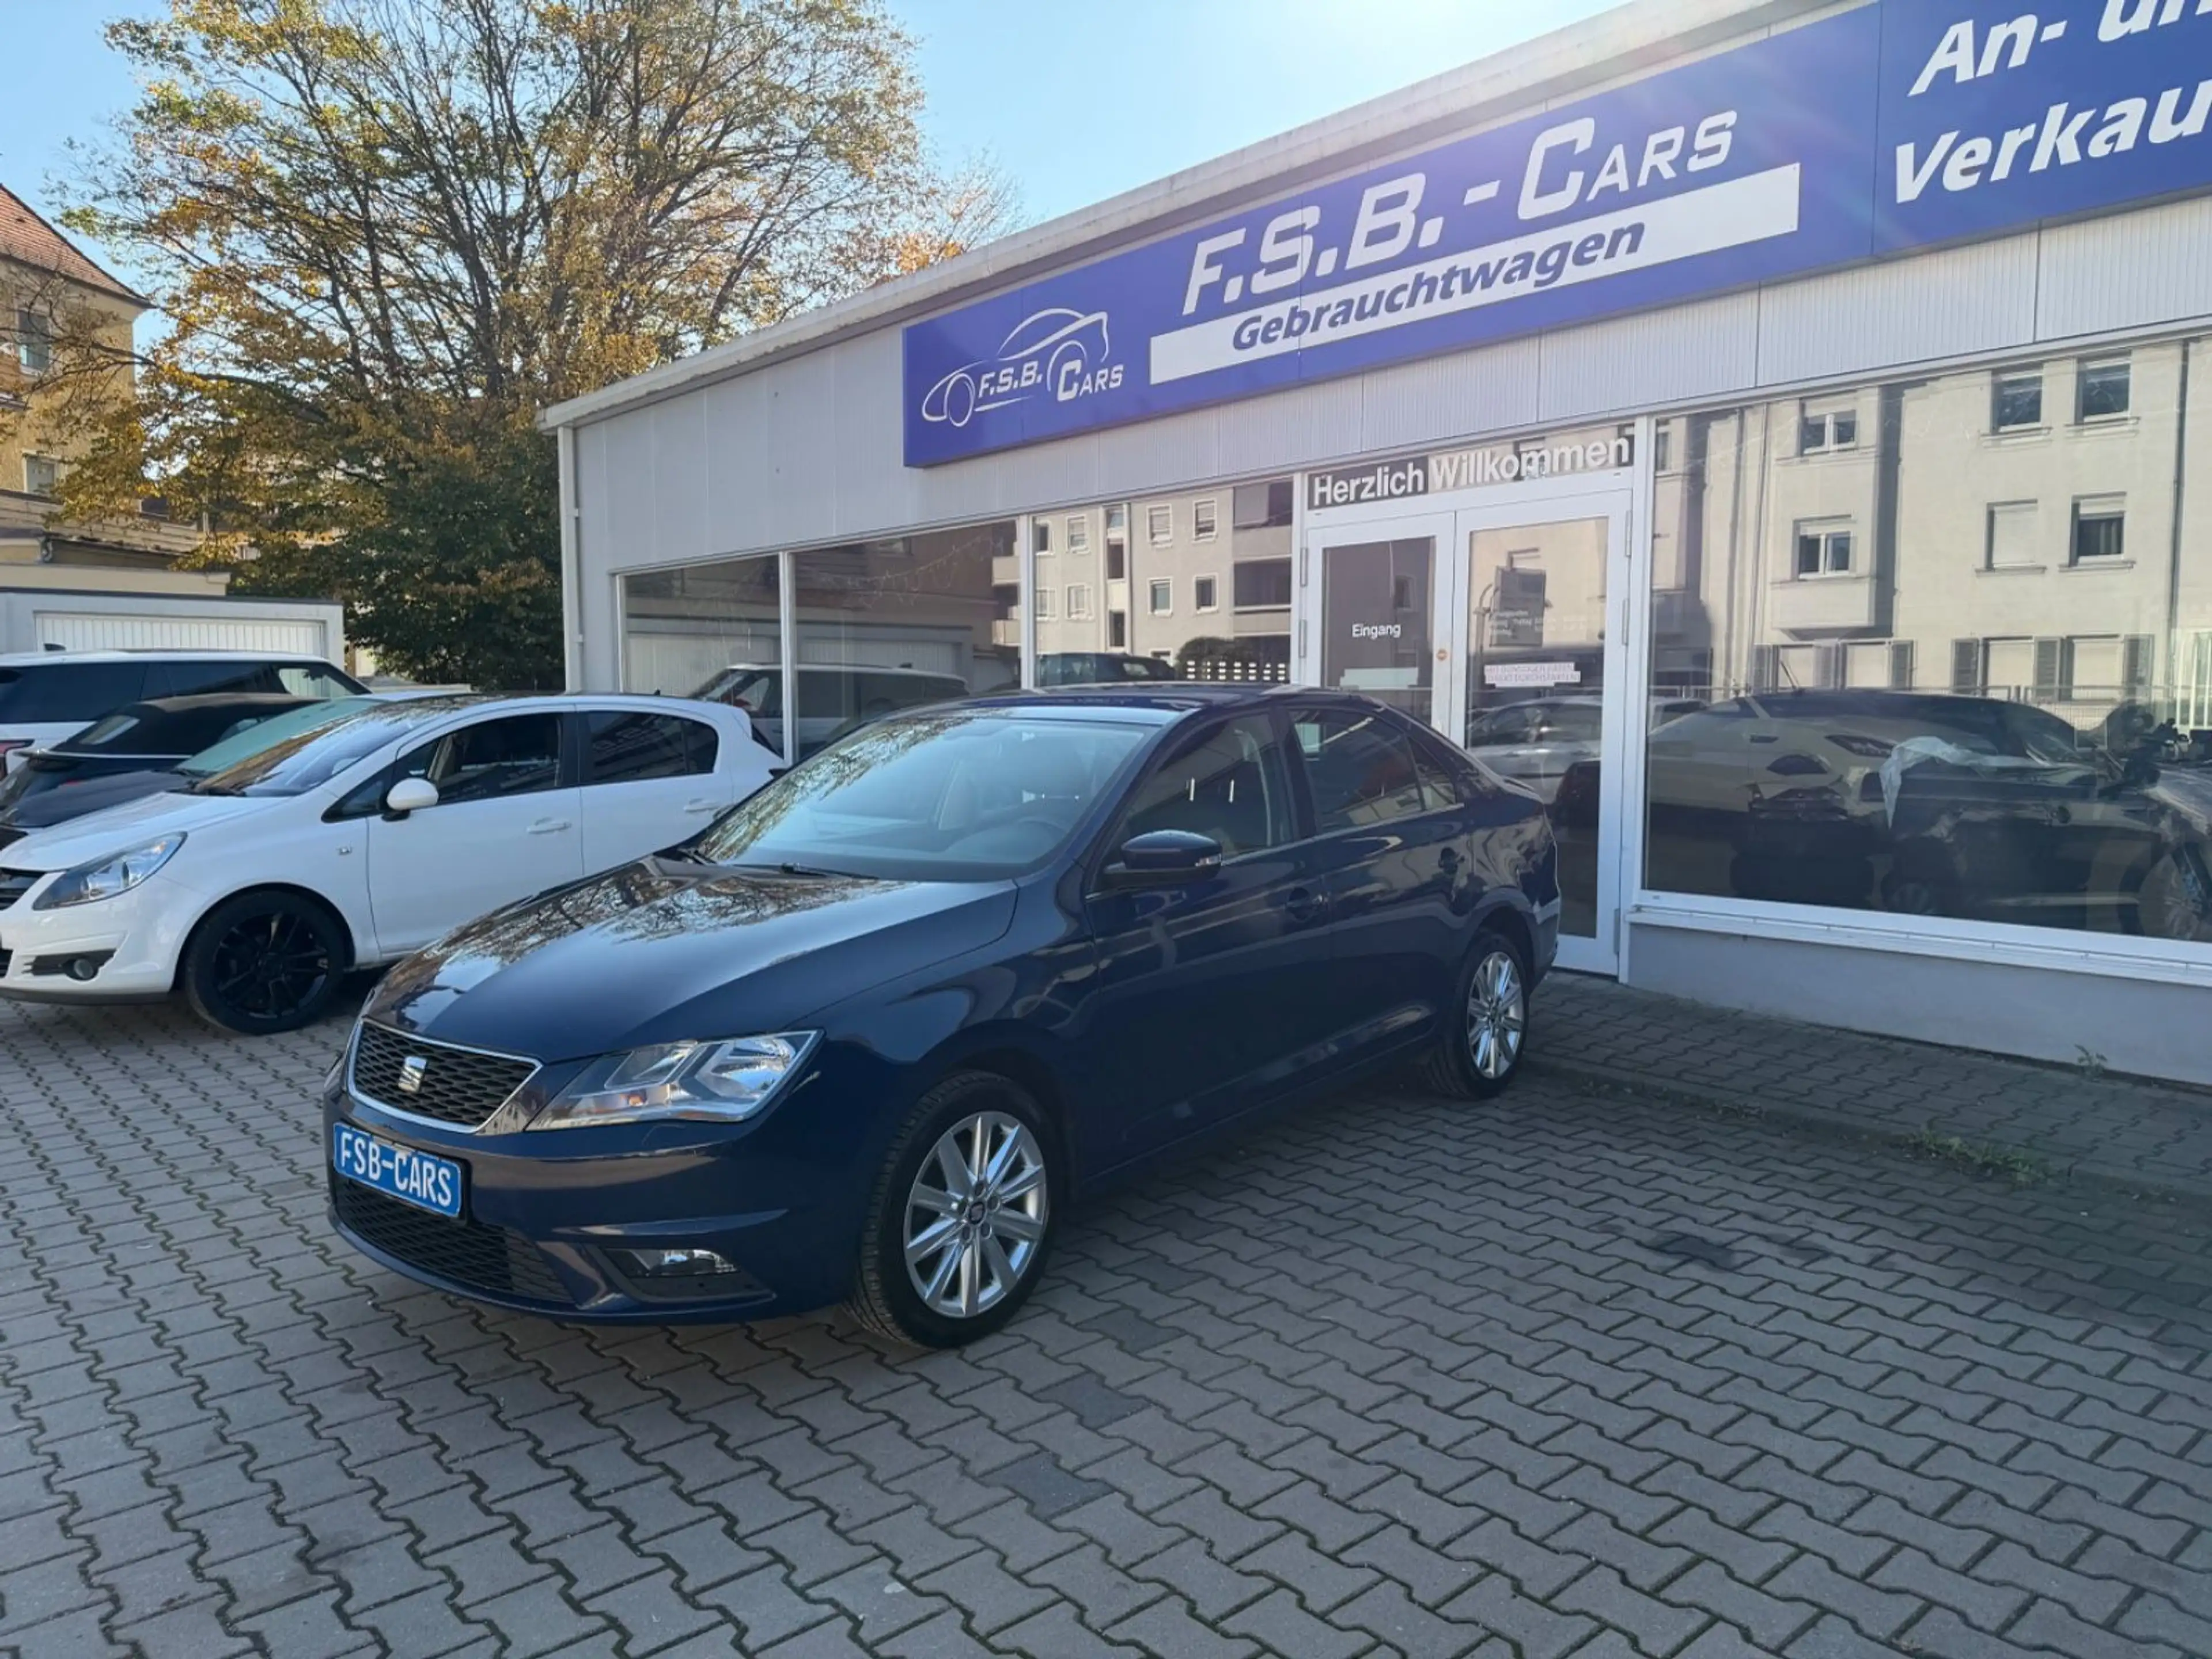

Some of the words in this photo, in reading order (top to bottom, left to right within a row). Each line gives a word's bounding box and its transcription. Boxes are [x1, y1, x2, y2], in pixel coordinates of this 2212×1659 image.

[1907, 14, 2067, 97] An-
[1896, 79, 2212, 203] Verkau
[1233, 221, 1645, 351] Gebrauchtwagen
[1313, 463, 1425, 506] Herzlich
[1430, 436, 1630, 488] Willkommen
[1352, 623, 1401, 639] Eingang
[341, 1131, 452, 1207] FSB-CARS
